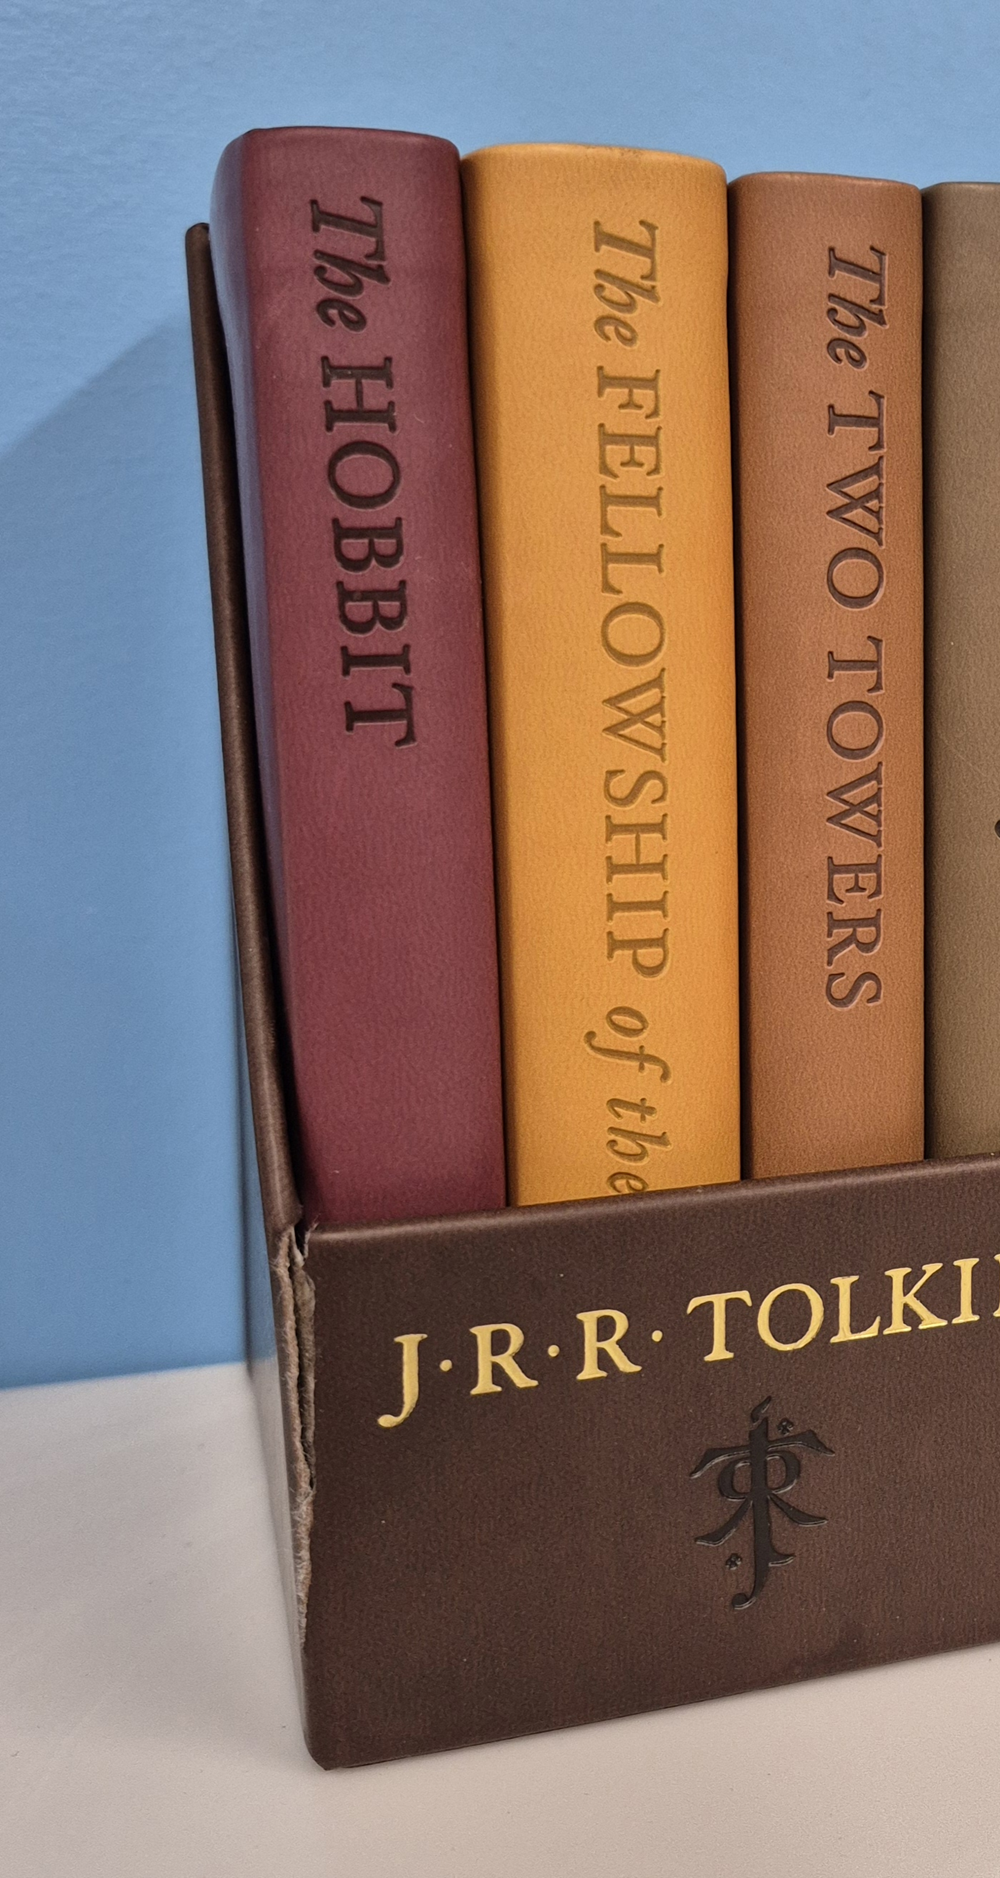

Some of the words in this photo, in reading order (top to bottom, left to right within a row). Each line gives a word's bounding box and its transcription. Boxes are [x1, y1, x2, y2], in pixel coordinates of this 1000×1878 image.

[309, 196, 392, 333] The
[593, 219, 661, 348] The
[825, 244, 889, 370] The
[320, 355, 418, 749] HOBBIT
[825, 389, 886, 612] TWO
[596, 365, 670, 979] FELLOWSHIP
[824, 634, 885, 1009] TOWERS
[584, 1005, 672, 1083] of
[606, 1097, 673, 1195] the
